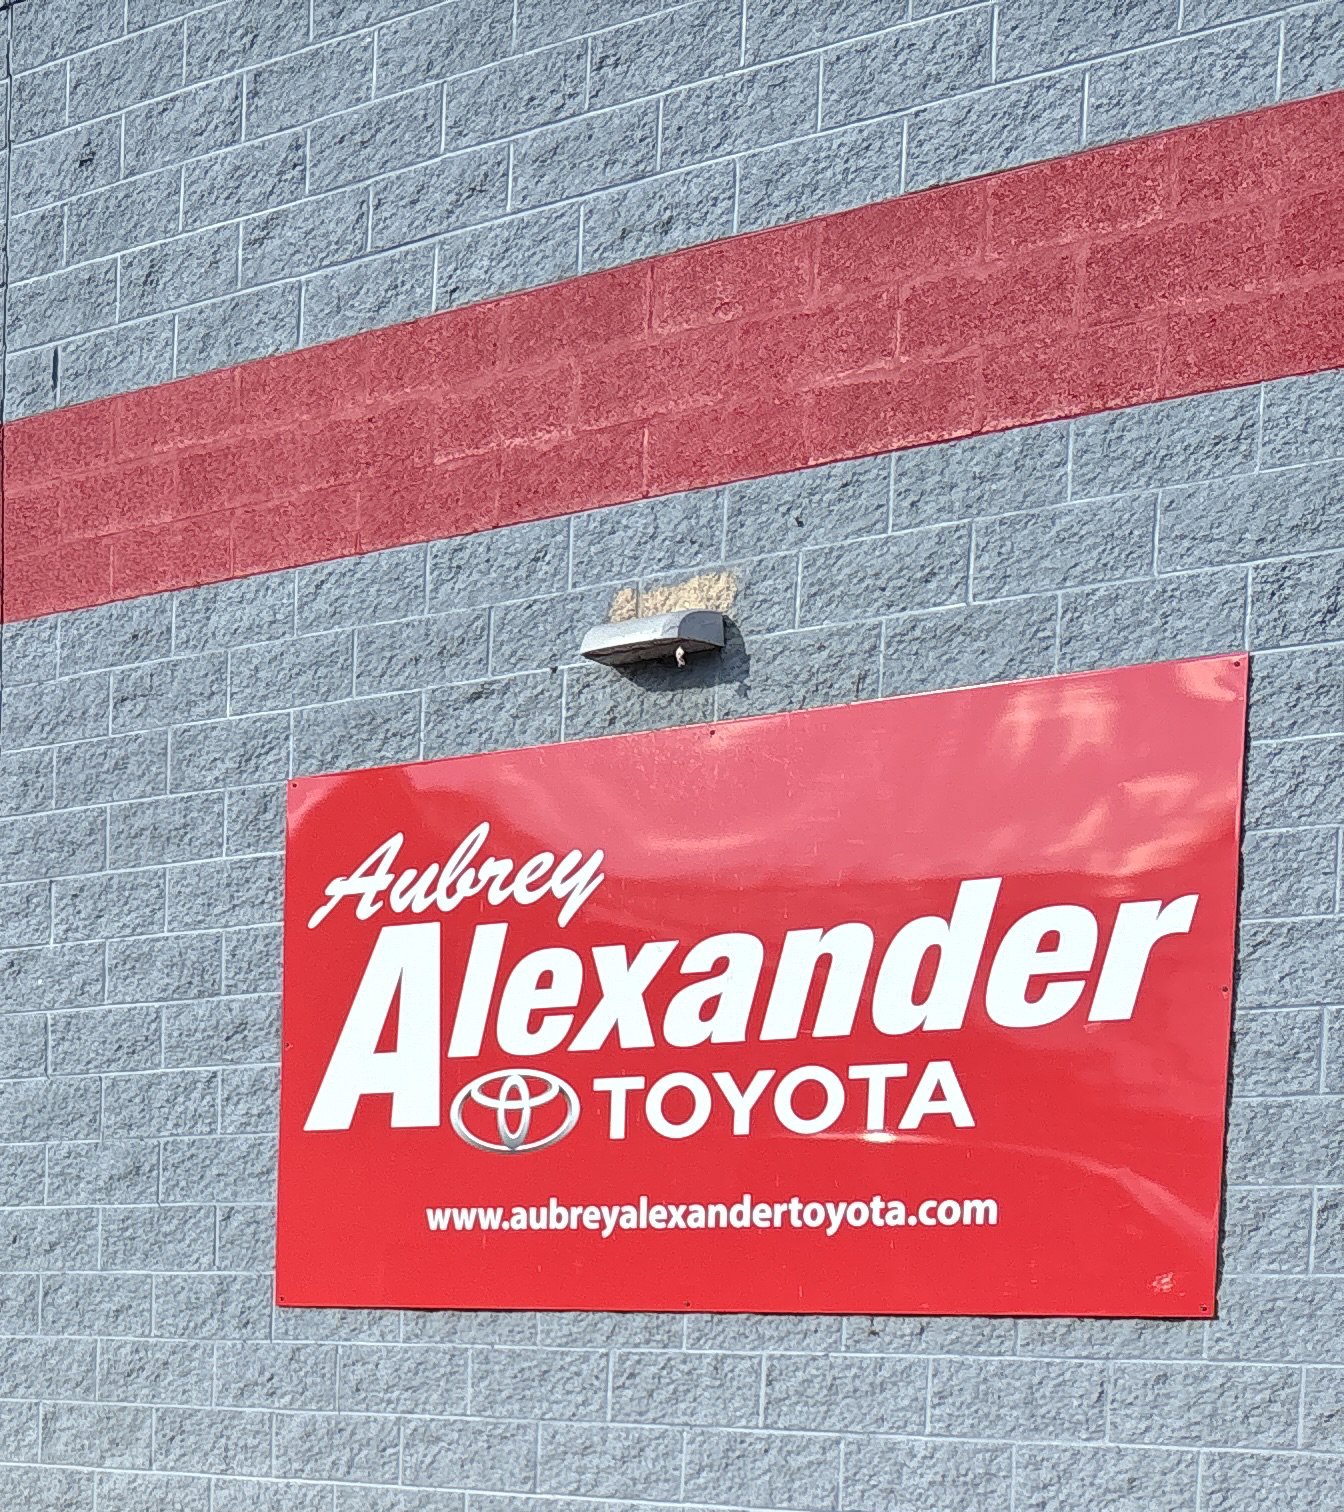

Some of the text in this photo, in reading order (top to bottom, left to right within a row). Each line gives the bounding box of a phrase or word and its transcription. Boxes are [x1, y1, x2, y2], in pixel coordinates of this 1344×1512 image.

[306, 820, 606, 930] Aubrey
[302, 876, 1201, 1132] Alexander
[591, 1059, 977, 1141] TOYOTA
[425, 1192, 999, 1239] www.aubreyalexandertoyota.com
